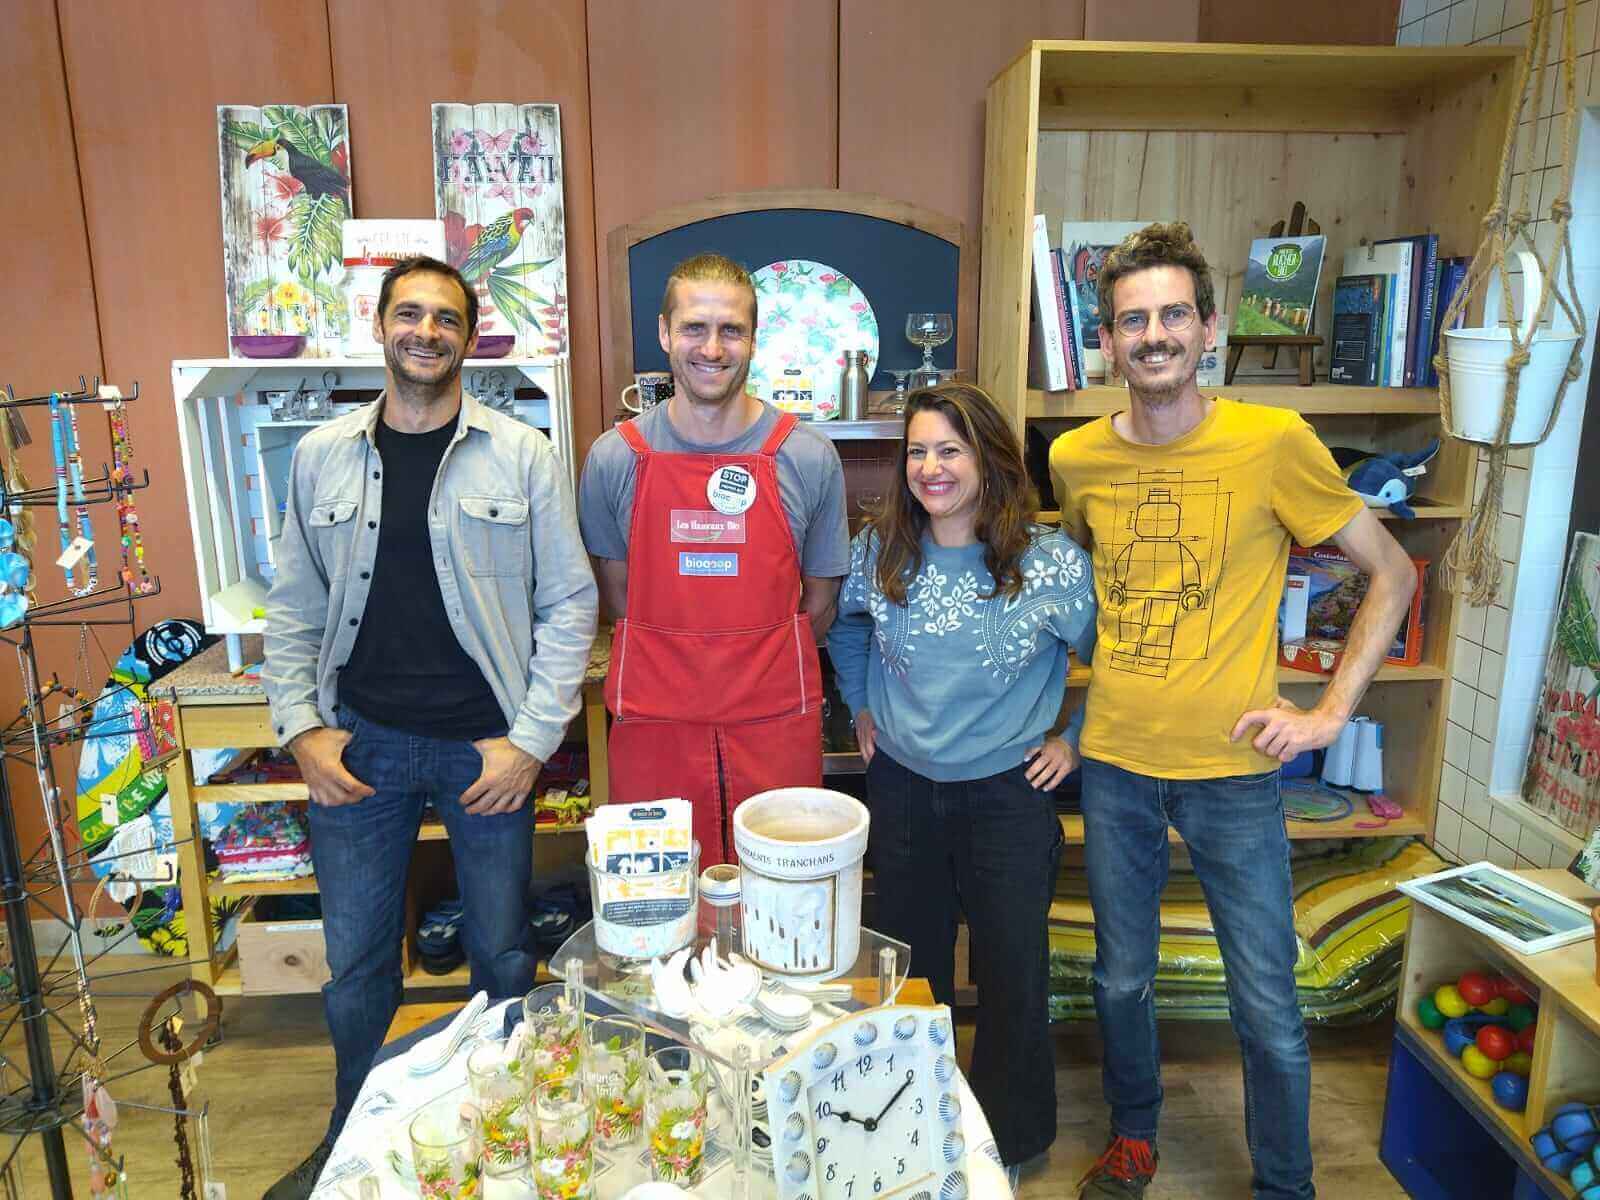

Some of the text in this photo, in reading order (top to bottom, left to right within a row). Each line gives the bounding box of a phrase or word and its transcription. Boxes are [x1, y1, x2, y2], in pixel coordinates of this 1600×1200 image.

[722, 469, 748, 484] STOP
[727, 520, 740, 530] Bio
[685, 556, 732, 572] biocoop
[1548, 689, 1600, 718] PARA
[777, 853, 834, 868] TRANCHANS
[855, 1054, 874, 1075] 12
[886, 1053, 895, 1073] 1
[831, 1070, 846, 1092] 11
[816, 1101, 832, 1120] 10
[914, 1098, 923, 1115] 3
[816, 1137, 826, 1154] 9
[910, 1129, 920, 1148] 4
[826, 1163, 836, 1181] 8
[896, 1158, 905, 1175] 5
[844, 1179, 855, 1198] 7
[873, 1176, 882, 1193] 6
